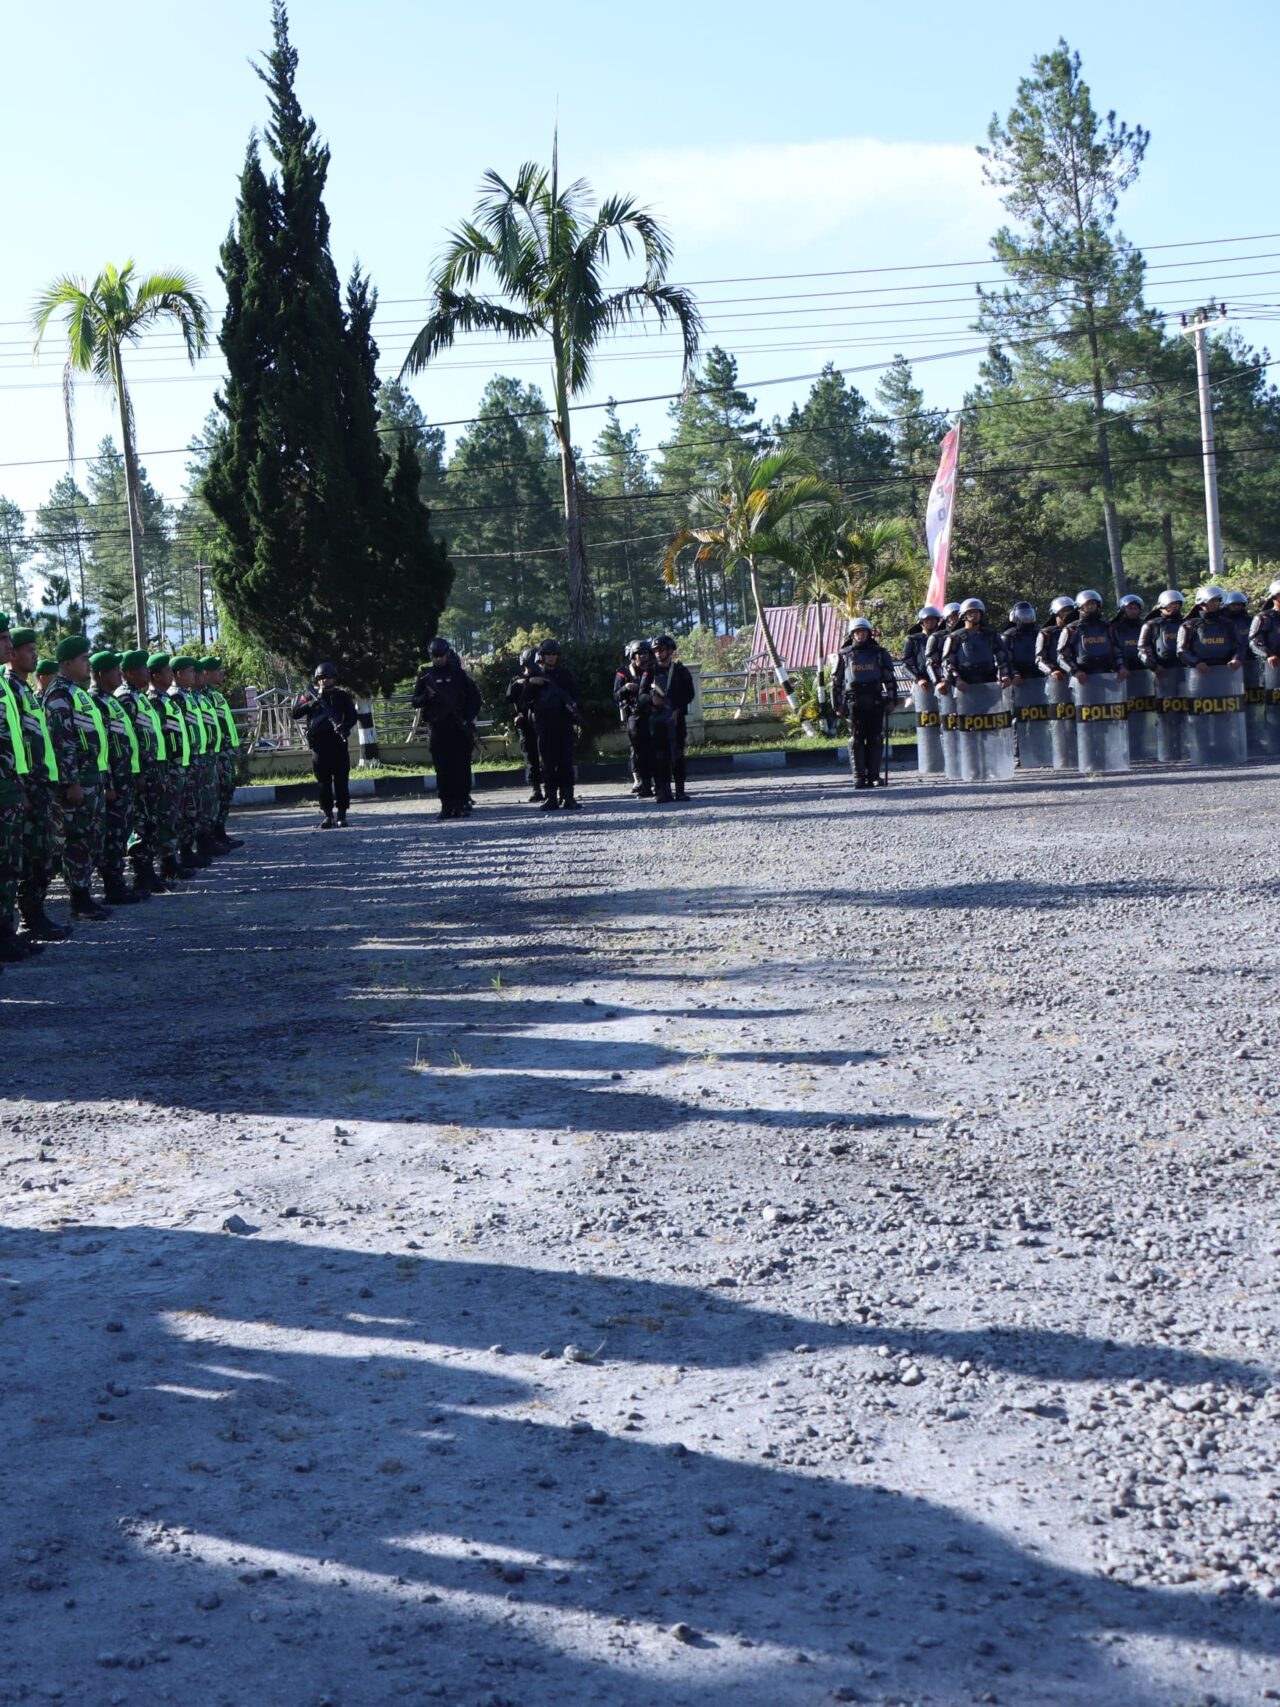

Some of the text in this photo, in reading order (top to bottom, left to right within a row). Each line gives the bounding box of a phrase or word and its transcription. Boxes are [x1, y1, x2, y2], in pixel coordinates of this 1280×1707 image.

[1082, 704, 1125, 721] POLISI
[1193, 697, 1240, 713] POLISI
[964, 713, 1008, 730] POLISI
